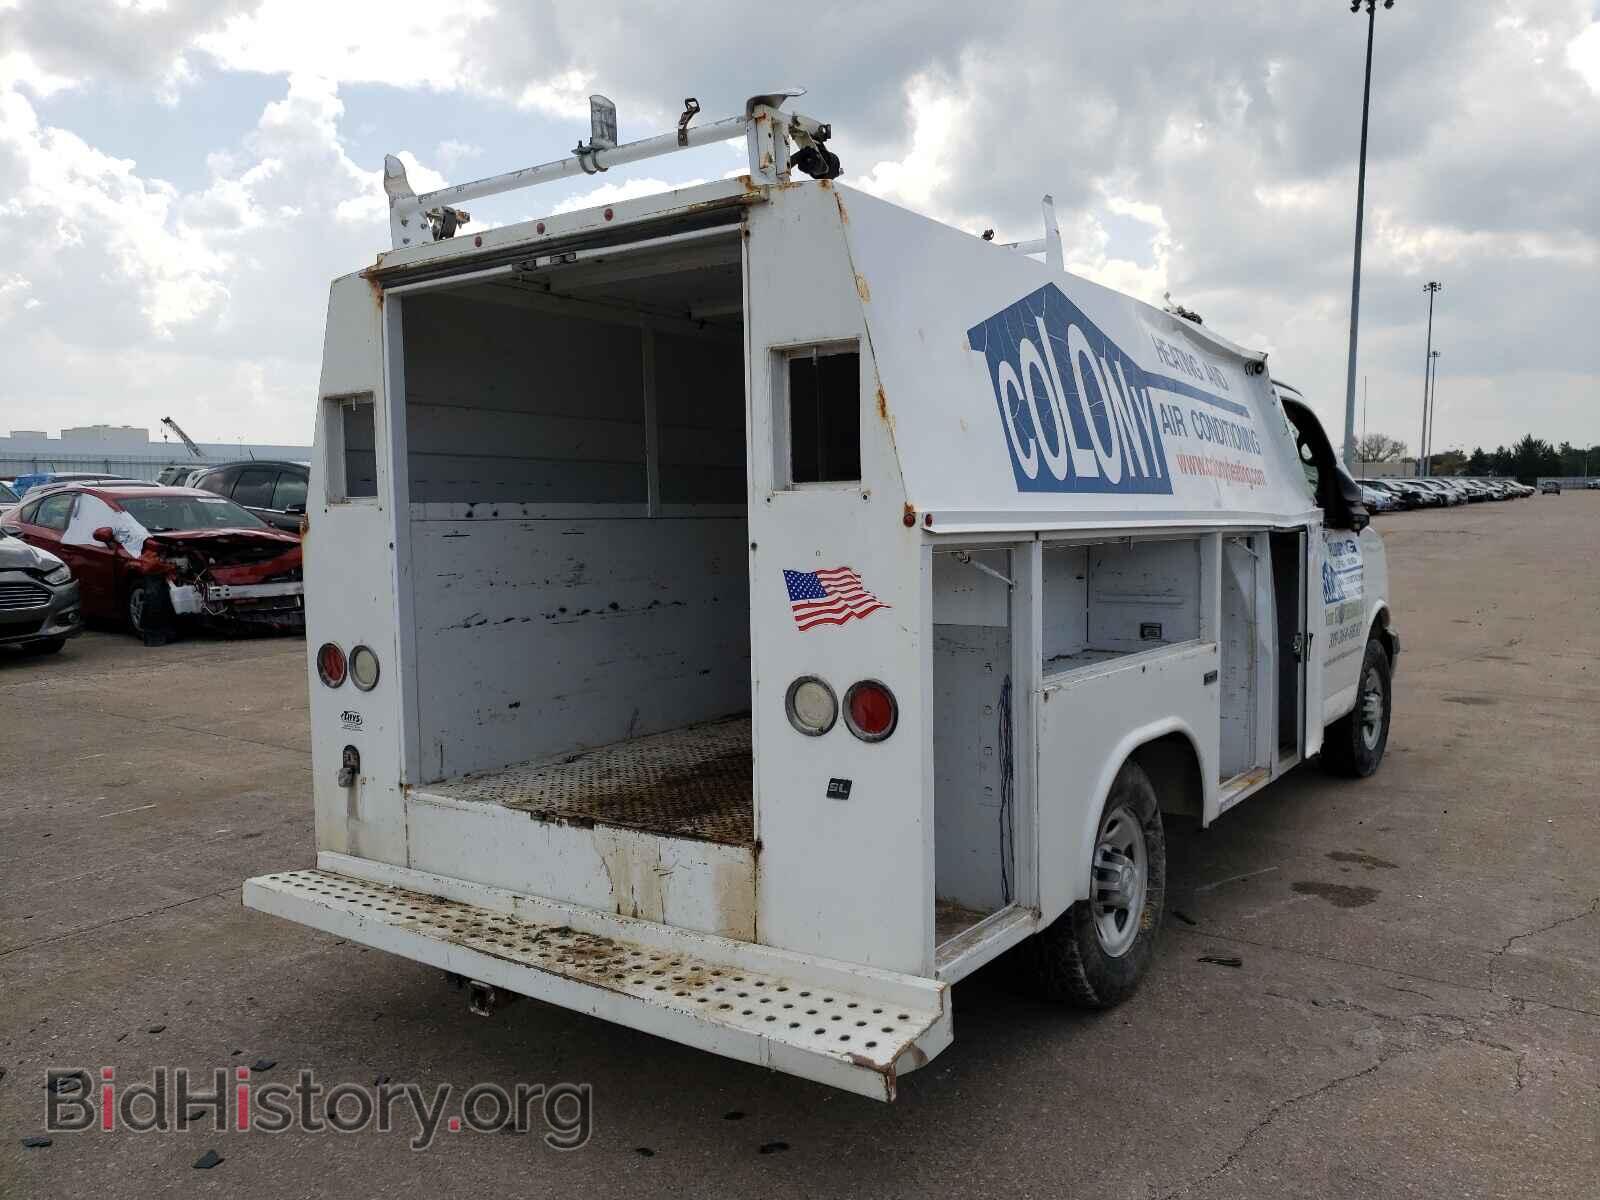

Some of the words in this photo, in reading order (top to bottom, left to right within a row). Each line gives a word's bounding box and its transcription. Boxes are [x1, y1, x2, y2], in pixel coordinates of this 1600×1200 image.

[1151, 334, 1203, 380] HEATING
[998, 316, 1162, 485] COLONY
[1159, 402, 1188, 438] AIR
[1190, 409, 1262, 456] CONDITIONING
